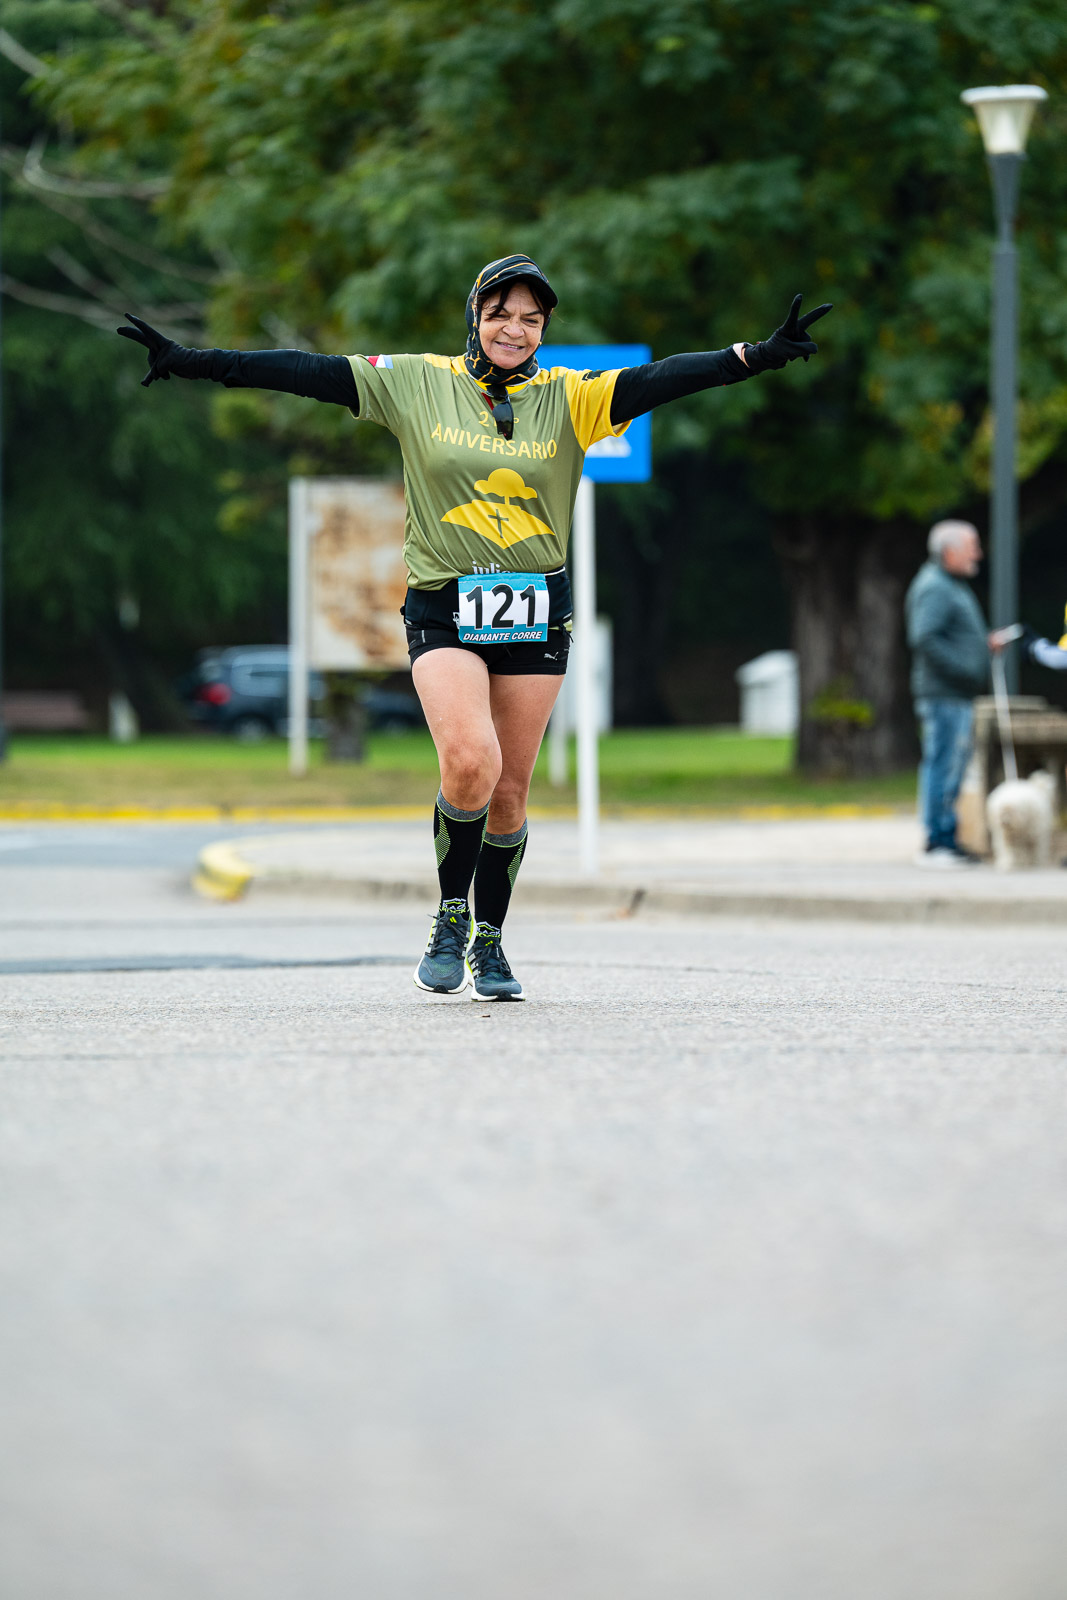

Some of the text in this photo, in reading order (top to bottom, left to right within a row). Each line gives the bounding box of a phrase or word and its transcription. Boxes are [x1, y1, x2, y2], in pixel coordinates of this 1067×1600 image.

[431, 422, 558, 460] ANIVERSARIO
[466, 583, 536, 630] 121
[463, 631, 543, 642] DIAMANTE CORRE
